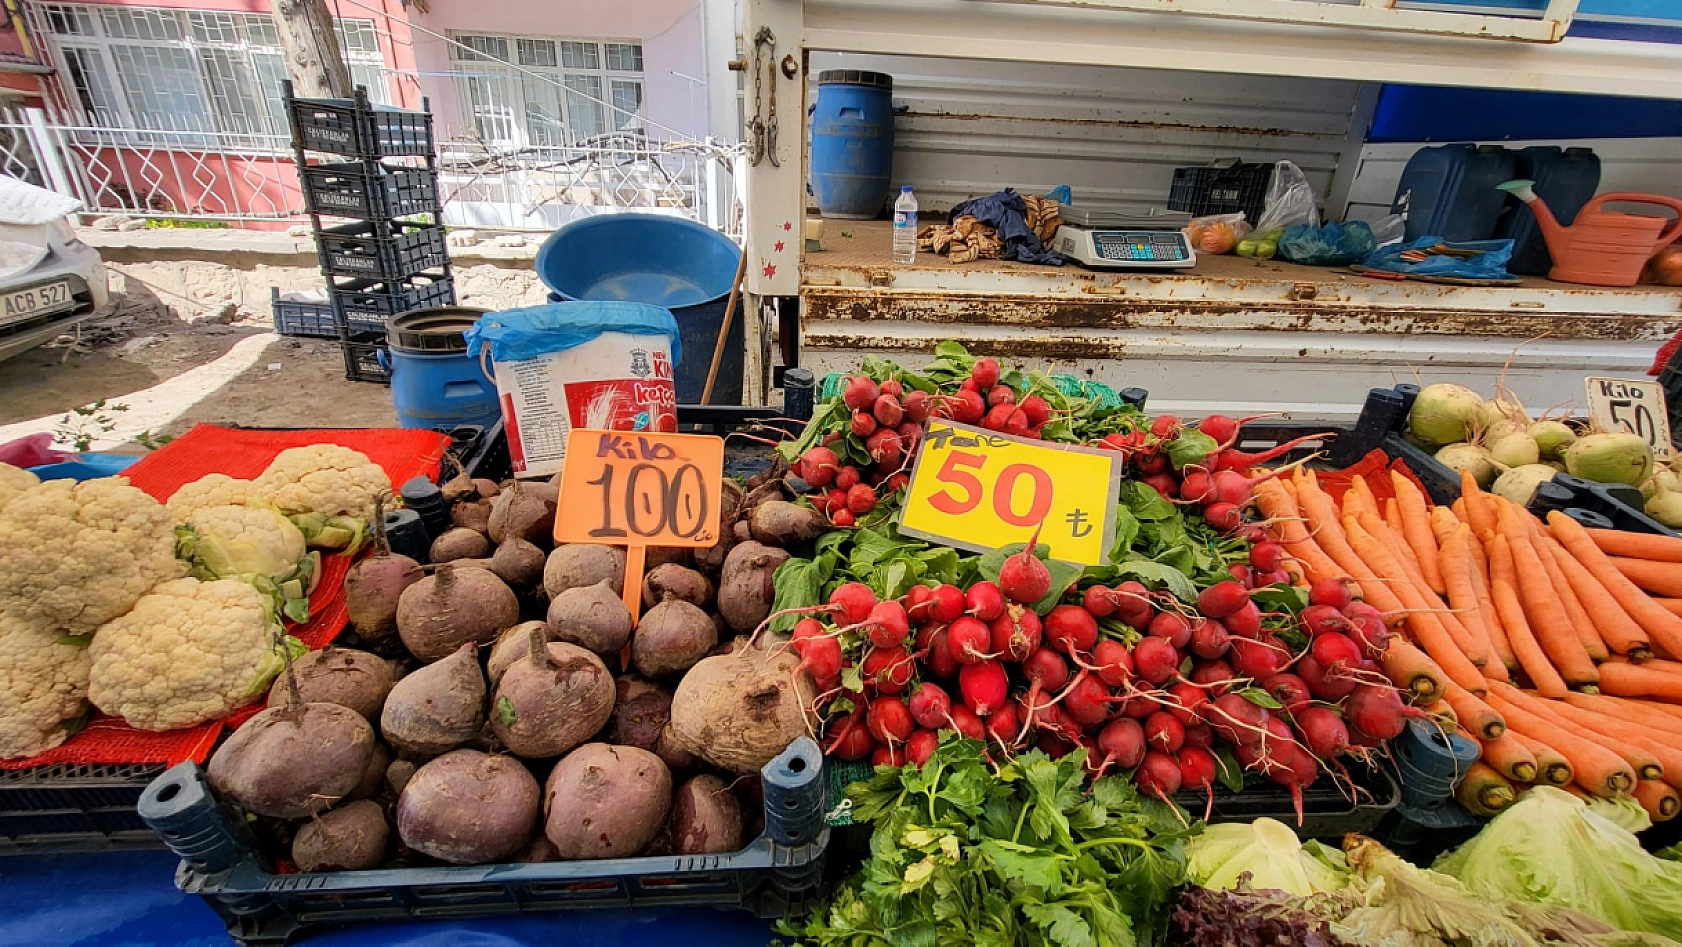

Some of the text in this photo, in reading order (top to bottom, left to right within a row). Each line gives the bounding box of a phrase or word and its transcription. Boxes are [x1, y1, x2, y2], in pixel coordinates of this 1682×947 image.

[5, 283, 66, 315] ACB 527
[1600, 381, 1644, 400] Kilo
[1609, 400, 1656, 446] 50
[596, 433, 677, 461] Kilo
[587, 463, 708, 538] 100
[927, 449, 1093, 538] 50 ₺
